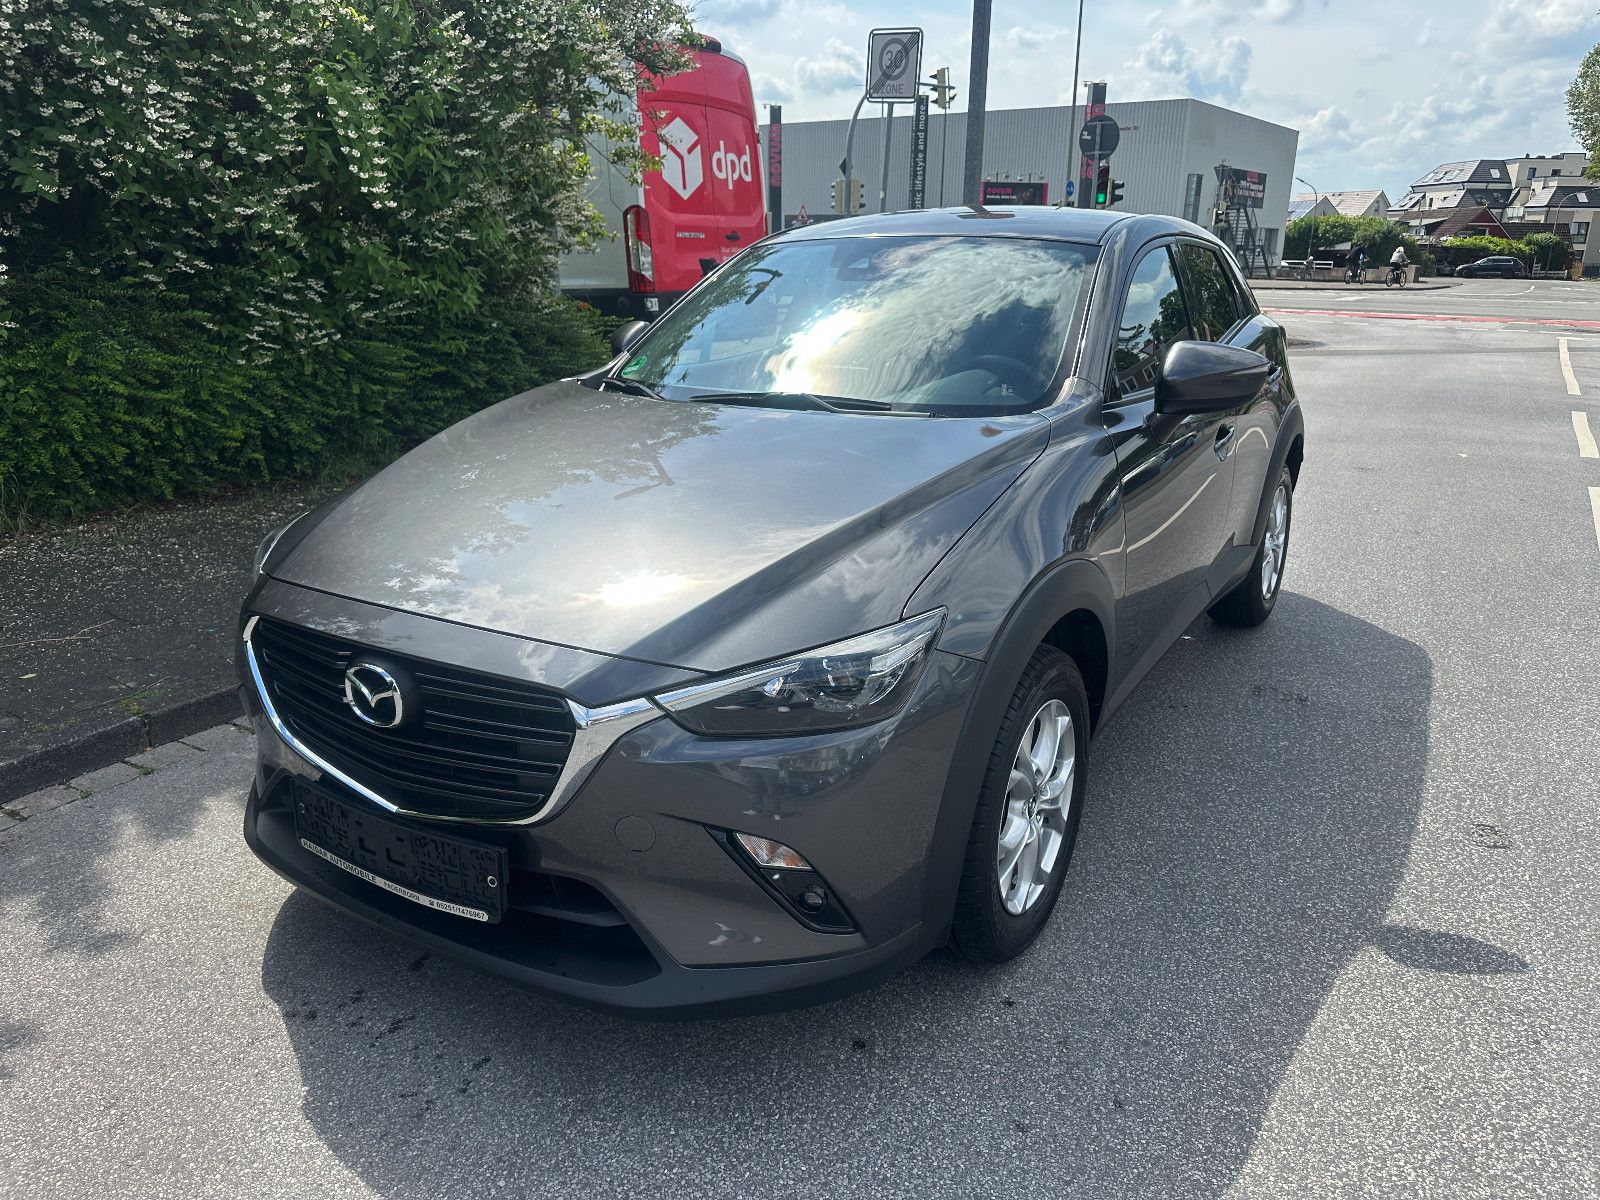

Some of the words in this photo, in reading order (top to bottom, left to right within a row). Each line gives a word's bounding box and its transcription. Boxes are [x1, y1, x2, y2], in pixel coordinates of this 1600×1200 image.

[711, 140, 752, 190] dpd
[769, 123, 782, 187] novum
[916, 132, 925, 151] and
[914, 152, 925, 190] lifestyle
[303, 840, 328, 860] HAIDAR
[329, 854, 377, 883] AUTOMOBILE
[383, 881, 420, 901] PADERBORN
